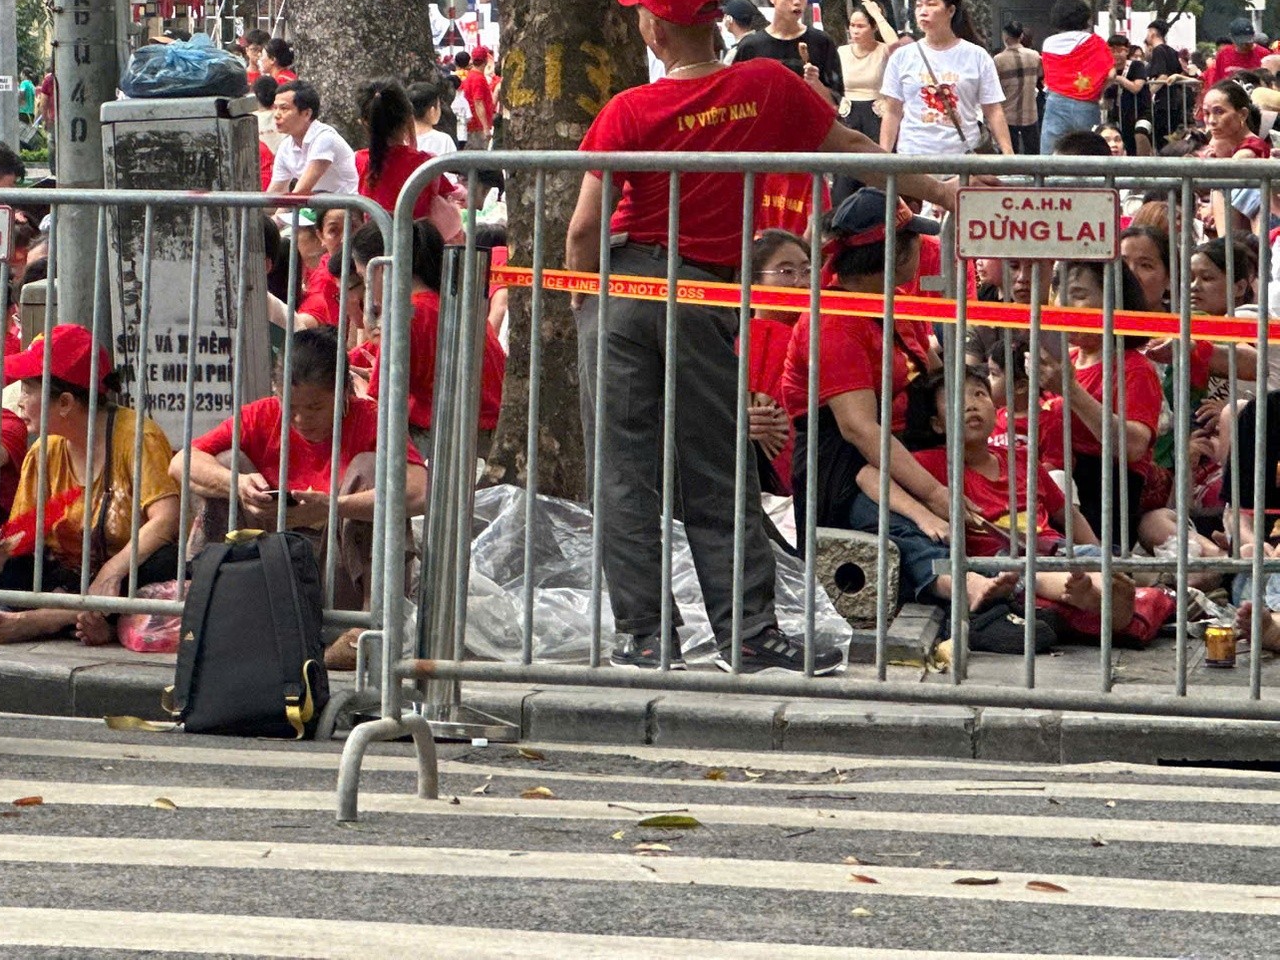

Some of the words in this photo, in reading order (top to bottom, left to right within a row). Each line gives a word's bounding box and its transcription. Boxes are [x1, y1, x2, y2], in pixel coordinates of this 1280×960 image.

[696, 106, 727, 127] VIỆT
[729, 102, 758, 121] NAM
[1002, 197, 1073, 211] C.A.H.N
[969, 213, 1050, 241] DỪNG
[1057, 221, 1106, 247] LẠI
[517, 273, 564, 288] POICE
[628, 283, 656, 295] NOT
[659, 286, 706, 299] COSS
